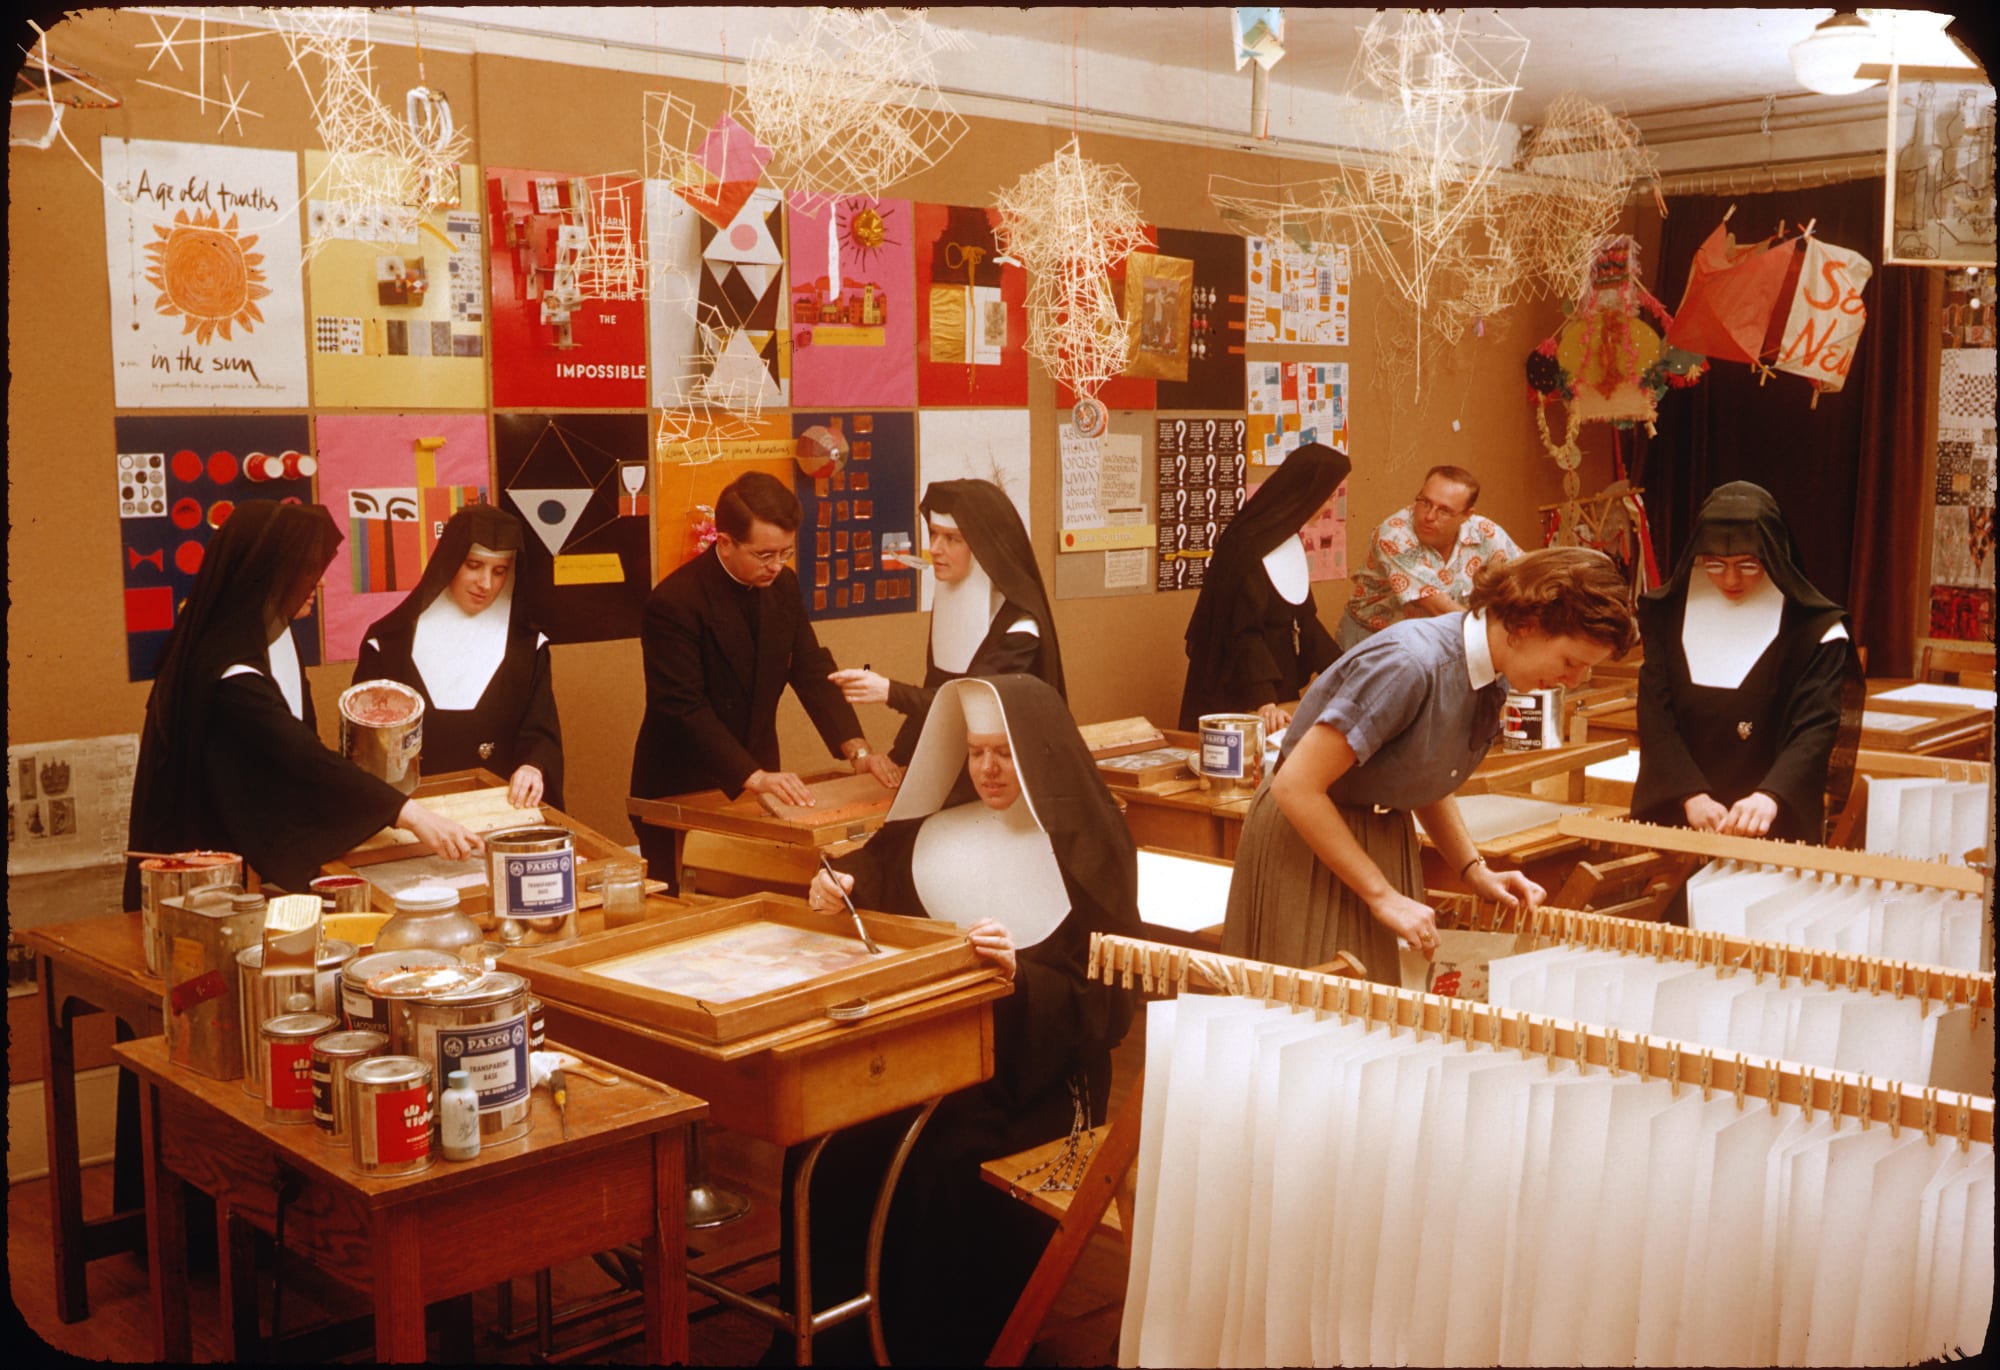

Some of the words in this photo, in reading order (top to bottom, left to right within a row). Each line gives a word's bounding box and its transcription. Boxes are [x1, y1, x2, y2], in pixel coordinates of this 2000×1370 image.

[137, 169, 174, 210] Age
[180, 175, 212, 210] old
[217, 182, 279, 212] truths
[599, 314, 617, 325] THE
[151, 344, 170, 374] in
[176, 345, 204, 374] the
[212, 357, 261, 384] sun
[556, 363, 647, 379] IMPOSSIBLE
[526, 862, 559, 873] PASCO
[467, 1032, 510, 1050] PASCO
[469, 1059, 509, 1073] TRANSPARENT
[483, 1073, 498, 1081] BASE
